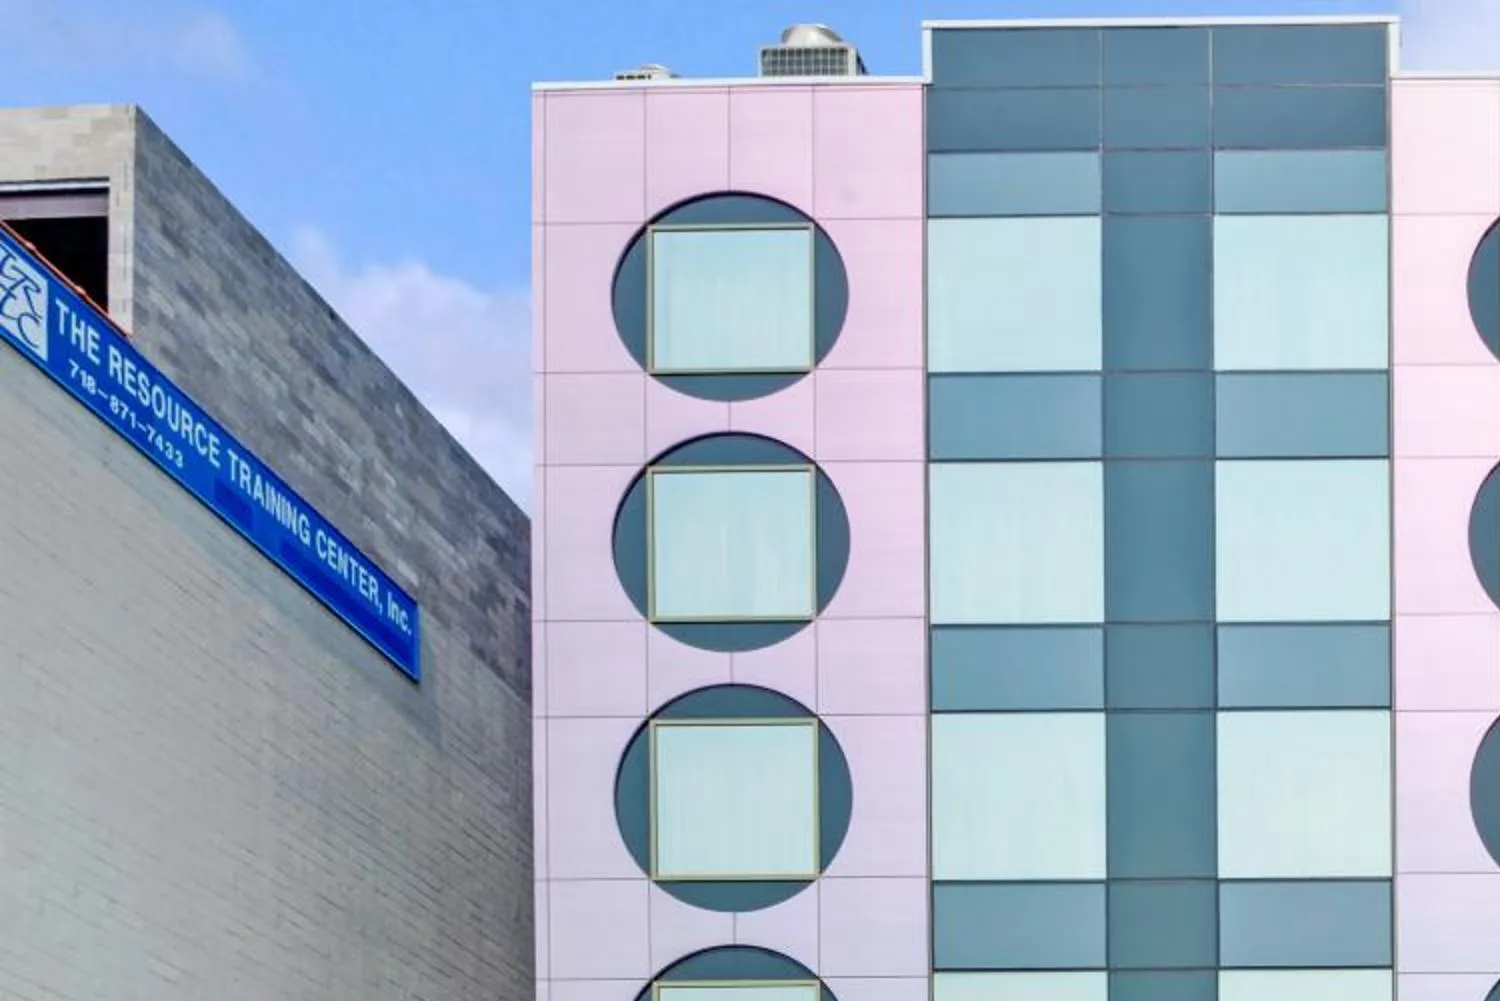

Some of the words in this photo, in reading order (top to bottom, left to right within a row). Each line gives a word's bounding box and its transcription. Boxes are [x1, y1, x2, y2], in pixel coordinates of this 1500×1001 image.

[56, 298, 101, 366] THE
[108, 344, 221, 469] RESOURCE
[227, 449, 311, 547] TRAINING
[315, 529, 383, 616] CENTER,
[387, 591, 412, 636] Inc.
[69, 358, 184, 469] 718-871-7433
